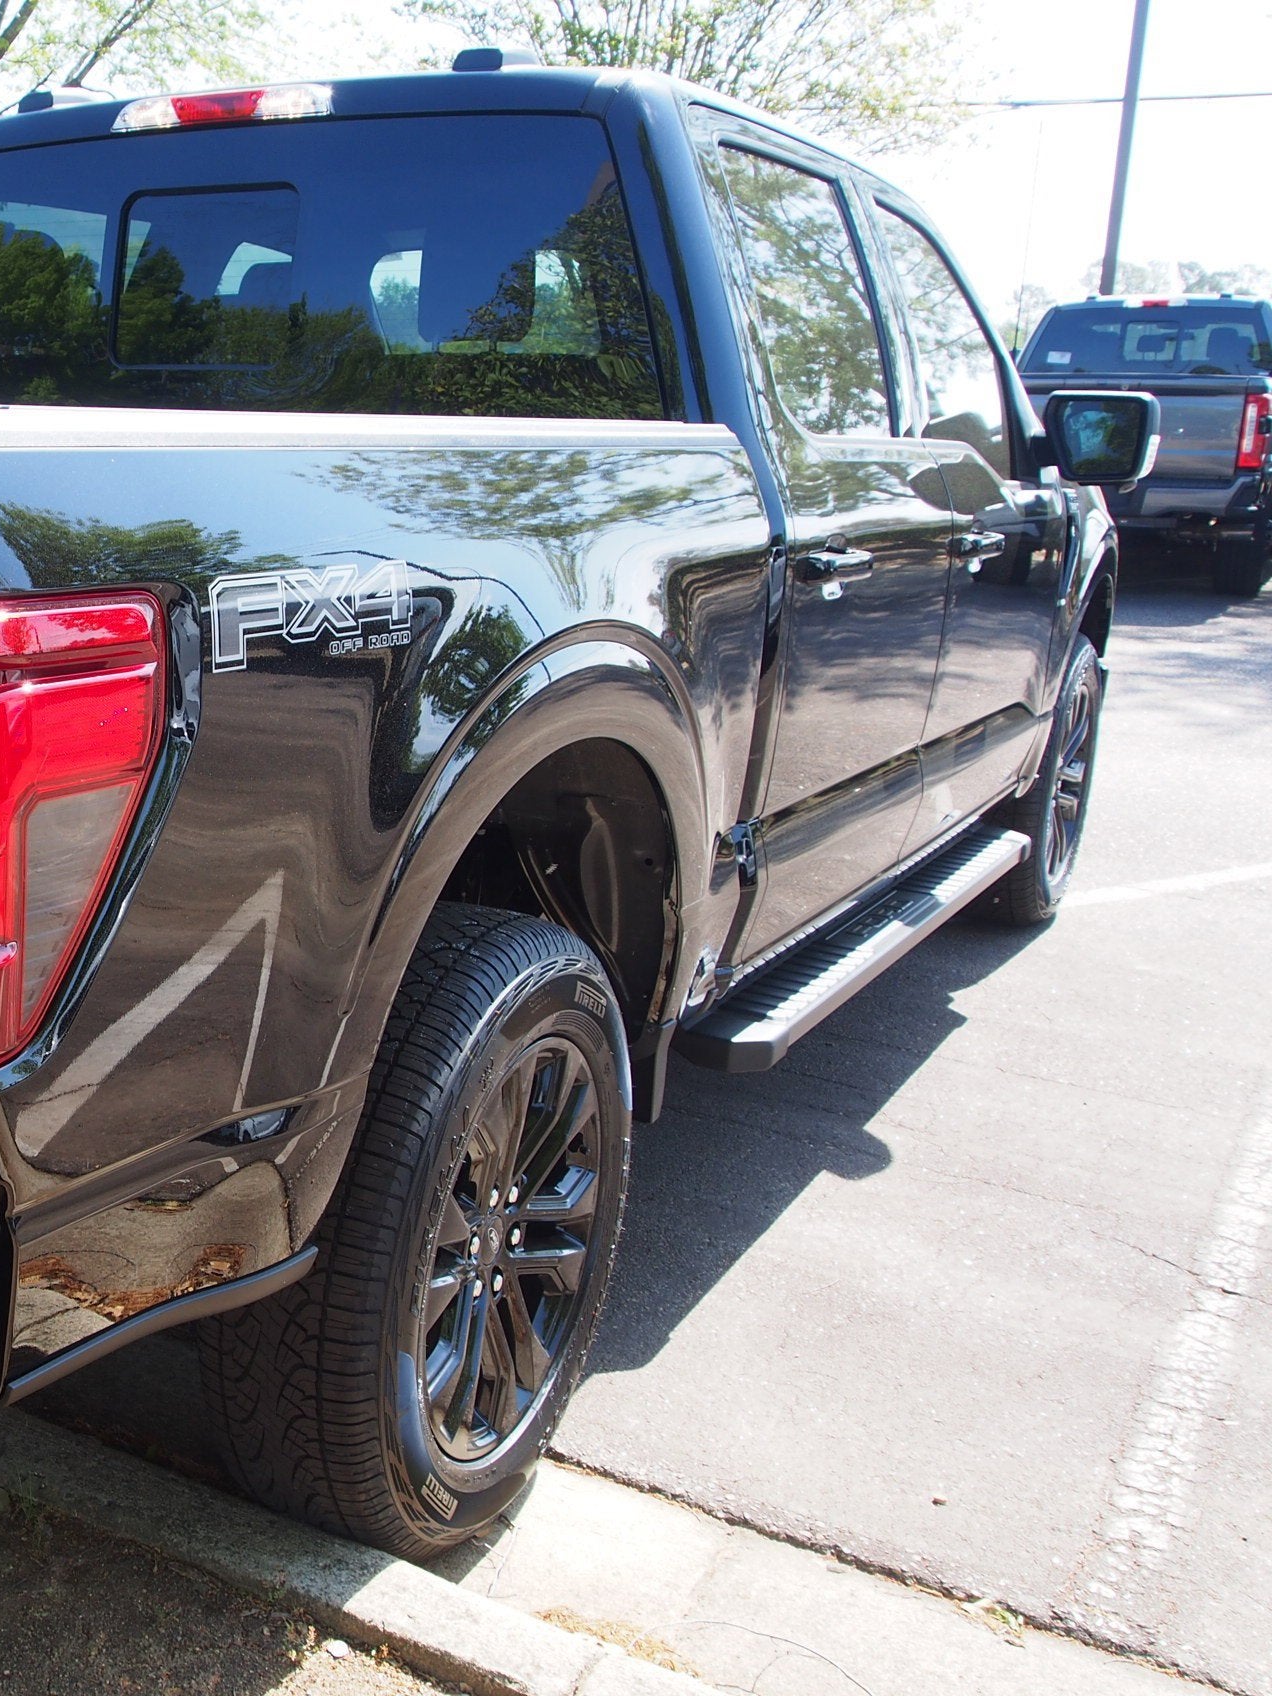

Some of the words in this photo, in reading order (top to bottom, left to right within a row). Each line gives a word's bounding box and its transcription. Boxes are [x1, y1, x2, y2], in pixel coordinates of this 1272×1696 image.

[208, 560, 413, 674] FX4
[329, 638, 364, 655] OFF
[368, 630, 411, 650] ROAD
[574, 980, 607, 1019] PIRELLI
[421, 1472, 459, 1521] PIRELLI
